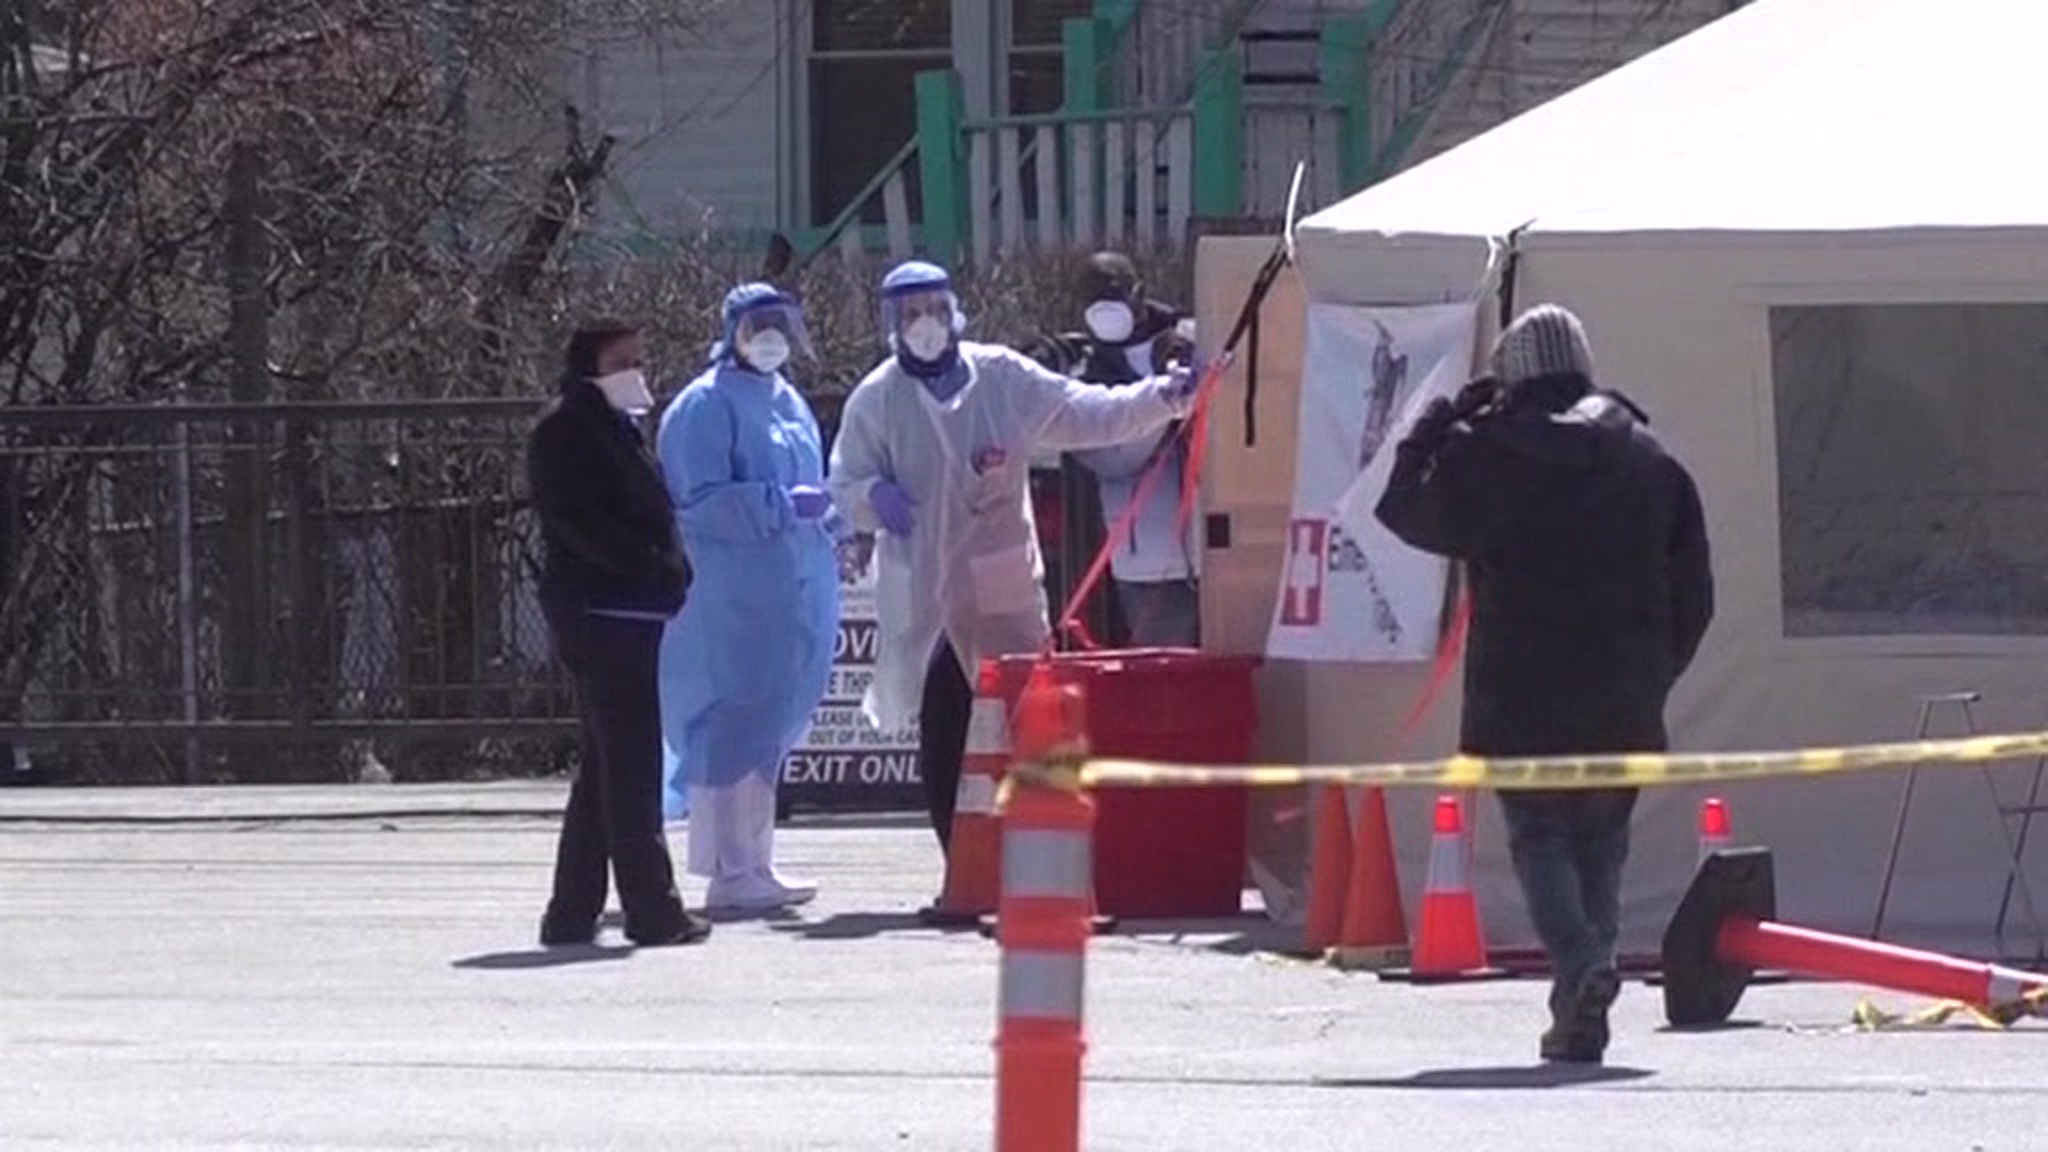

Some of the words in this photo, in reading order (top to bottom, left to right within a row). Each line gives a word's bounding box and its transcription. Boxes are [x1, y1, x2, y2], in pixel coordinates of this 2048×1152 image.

[833, 627, 878, 658] OVI
[842, 671, 873, 694] THR
[808, 730, 835, 744] OUT
[838, 730, 855, 744] OF
[782, 755, 854, 783] EXIT
[859, 755, 922, 783] ONL
